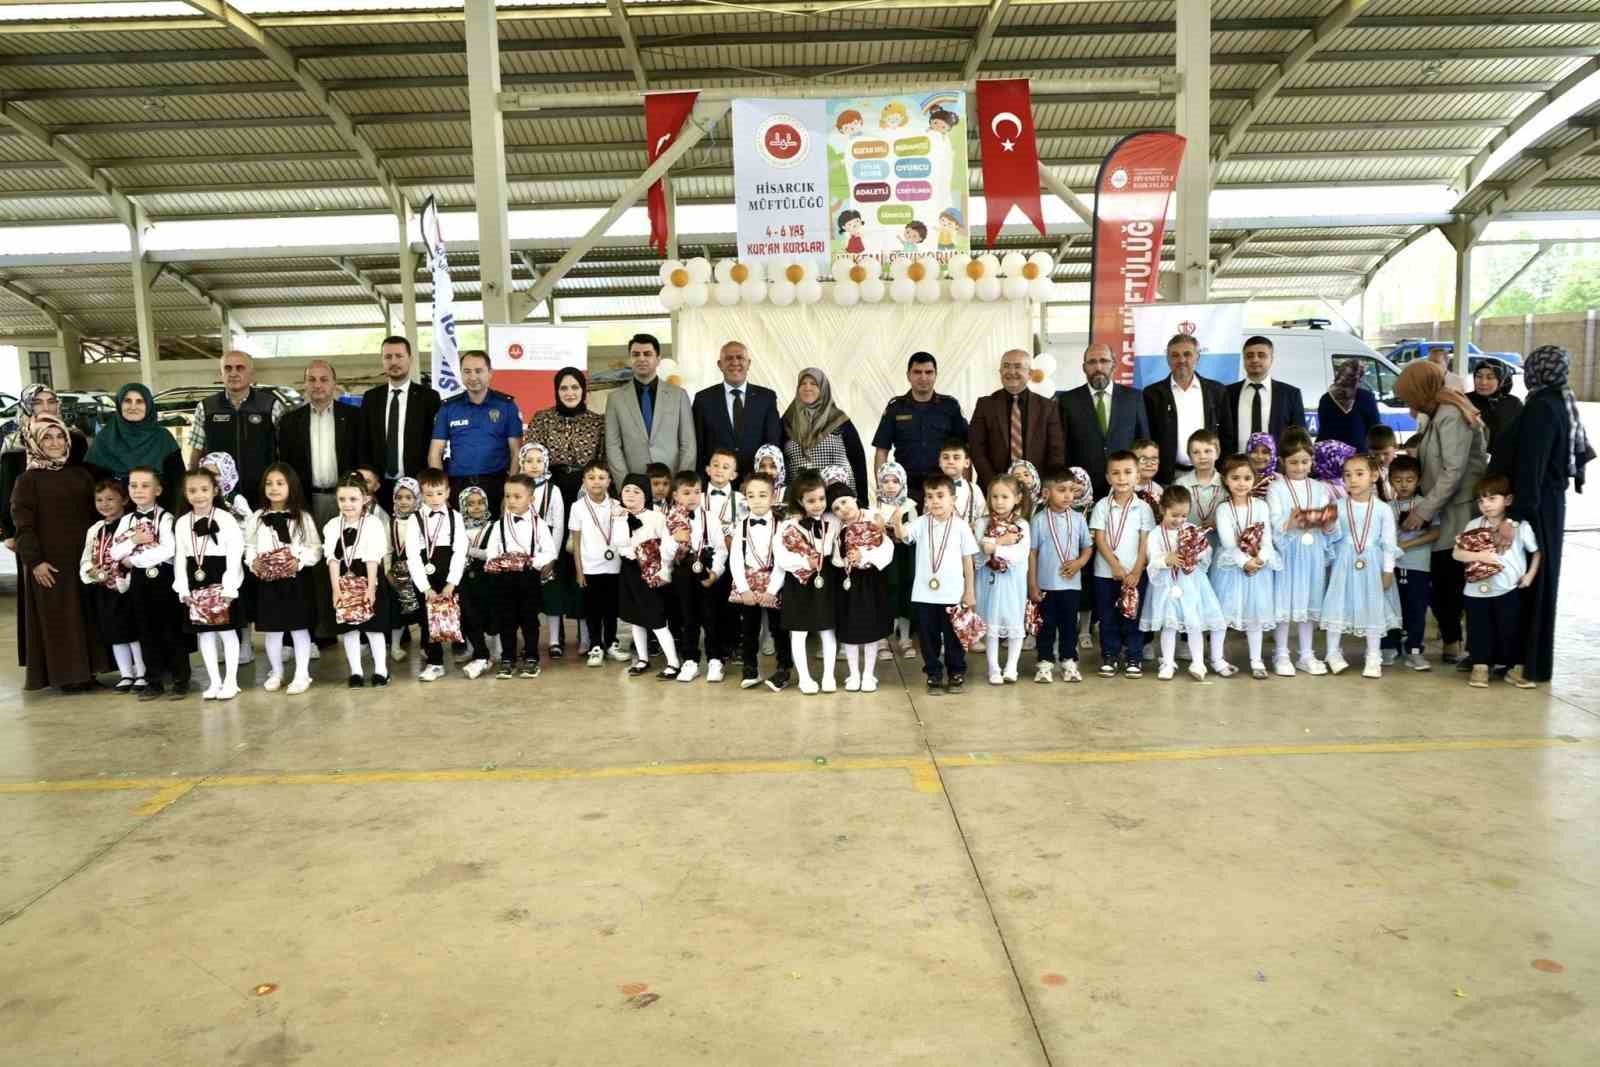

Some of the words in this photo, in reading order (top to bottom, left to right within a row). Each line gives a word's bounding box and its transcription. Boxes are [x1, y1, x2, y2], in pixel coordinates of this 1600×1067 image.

[756, 181, 815, 194] HİSARCIK
[748, 195, 824, 211] MÜFTÜLÜĞÜ
[766, 225, 772, 238] 4
[780, 225, 786, 237] 6
[789, 224, 805, 239] YAŞ
[747, 242, 780, 256] KUR'AN
[783, 240, 825, 254] KURSLARI
[1119, 218, 1154, 334] MÜFTÜLÜĞ
